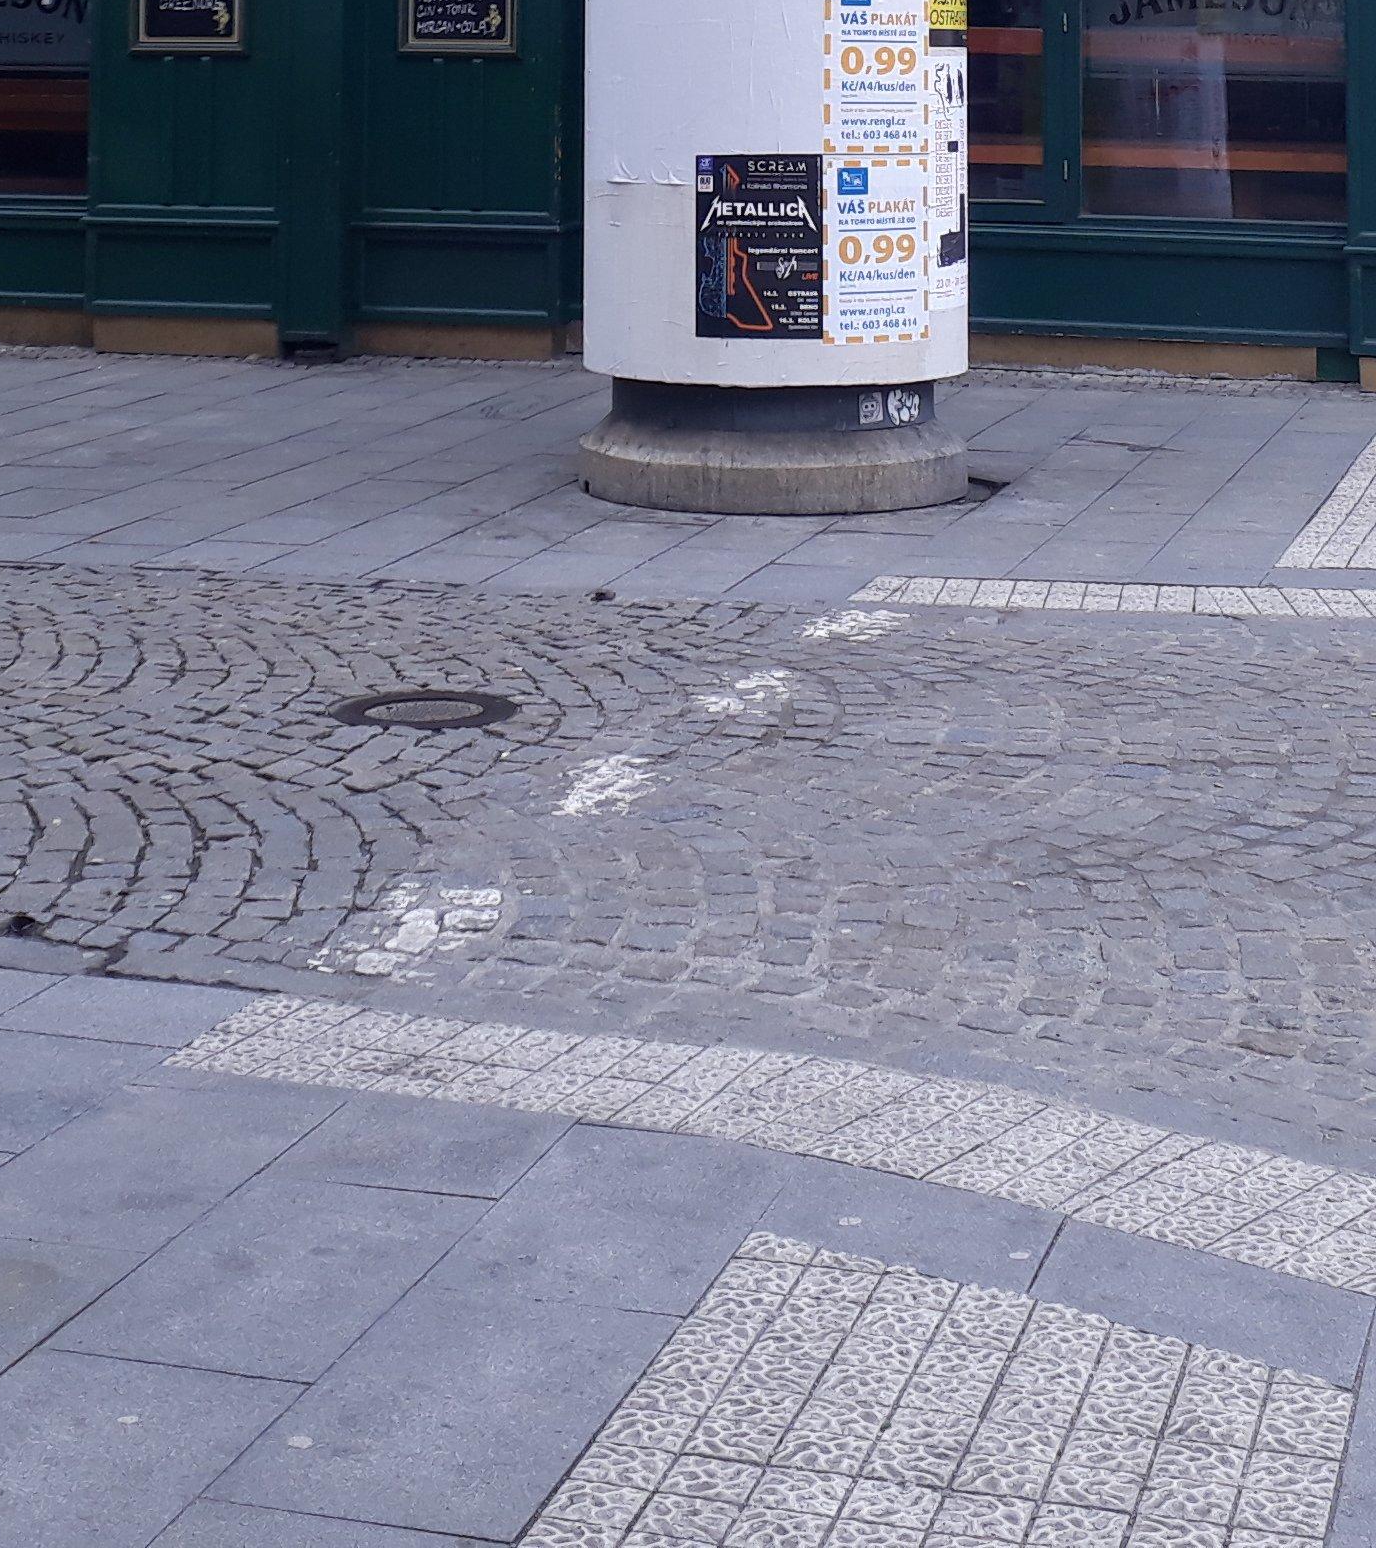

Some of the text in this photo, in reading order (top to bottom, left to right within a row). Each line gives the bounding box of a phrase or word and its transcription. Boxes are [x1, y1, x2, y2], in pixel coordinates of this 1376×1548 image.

[840, 10, 918, 26] VÁŠ PLAKÁT
[840, 46, 917, 76] 0,99
[841, 80, 917, 92] Kč/A4/kus/den
[841, 117, 906, 128] www.rengl.cz
[863, 131, 881, 140] 603
[883, 131, 900, 140] 468
[902, 130, 917, 139] 414
[747, 160, 807, 172] SCREAM
[837, 197, 916, 214] VÁŠ PLAKÁT
[700, 195, 819, 232] METALLICA
[838, 234, 916, 265] 0,99
[839, 270, 916, 282] Kč/A4/kus/den
[839, 305, 906, 319] www.rengl.cz
[862, 321, 881, 330] 603
[883, 319, 900, 328] 468
[901, 317, 917, 327] 414
